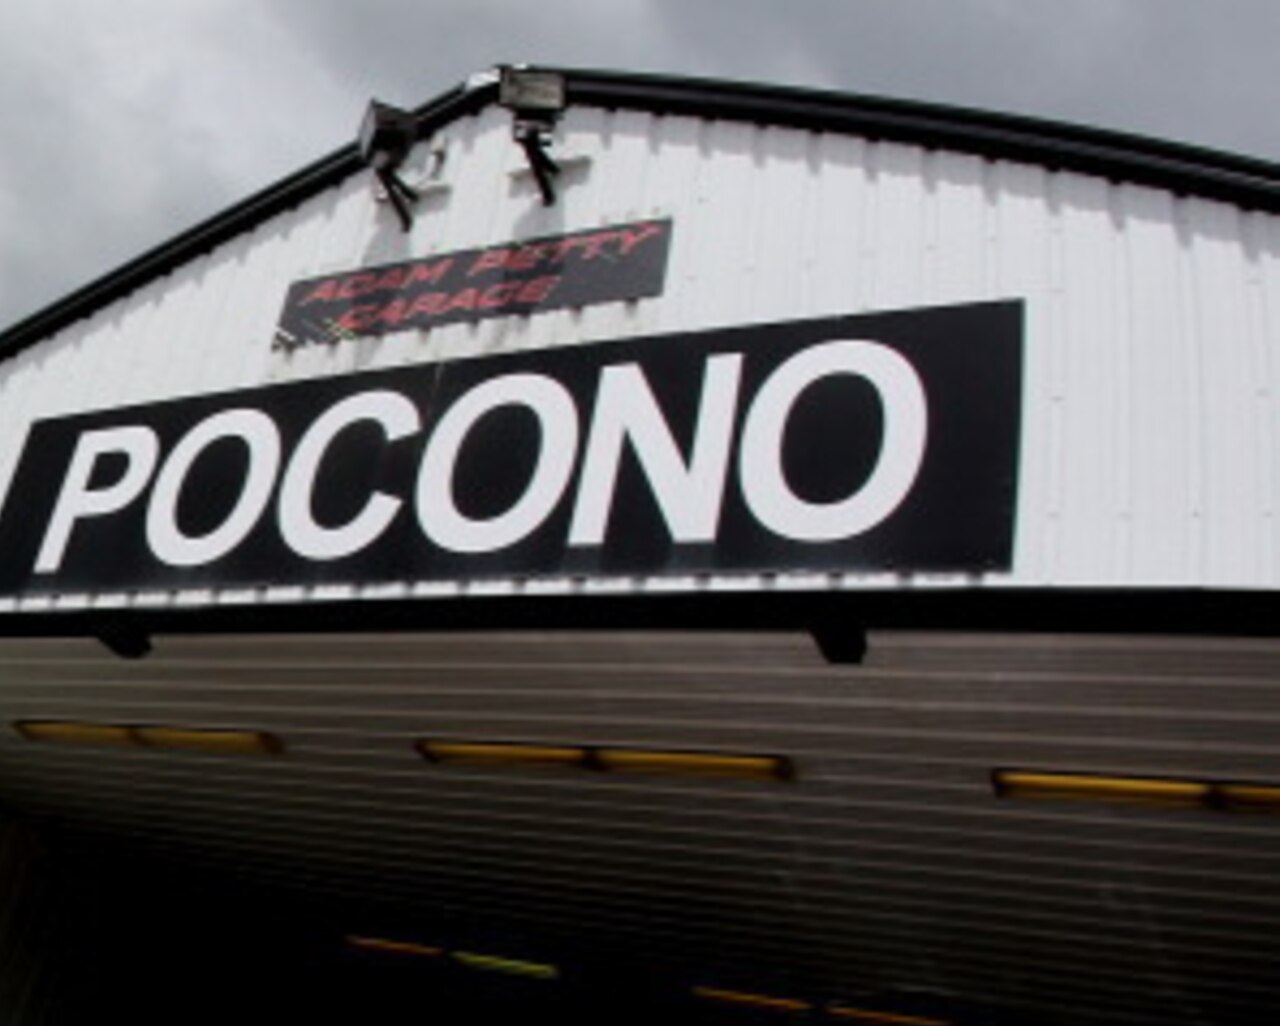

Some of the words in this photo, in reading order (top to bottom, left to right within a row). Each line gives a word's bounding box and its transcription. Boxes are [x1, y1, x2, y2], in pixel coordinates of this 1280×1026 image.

[299, 257, 456, 306] ADAM
[465, 222, 662, 277] PETTY
[337, 274, 562, 331] GARAGE
[33, 338, 929, 575] POCONO
